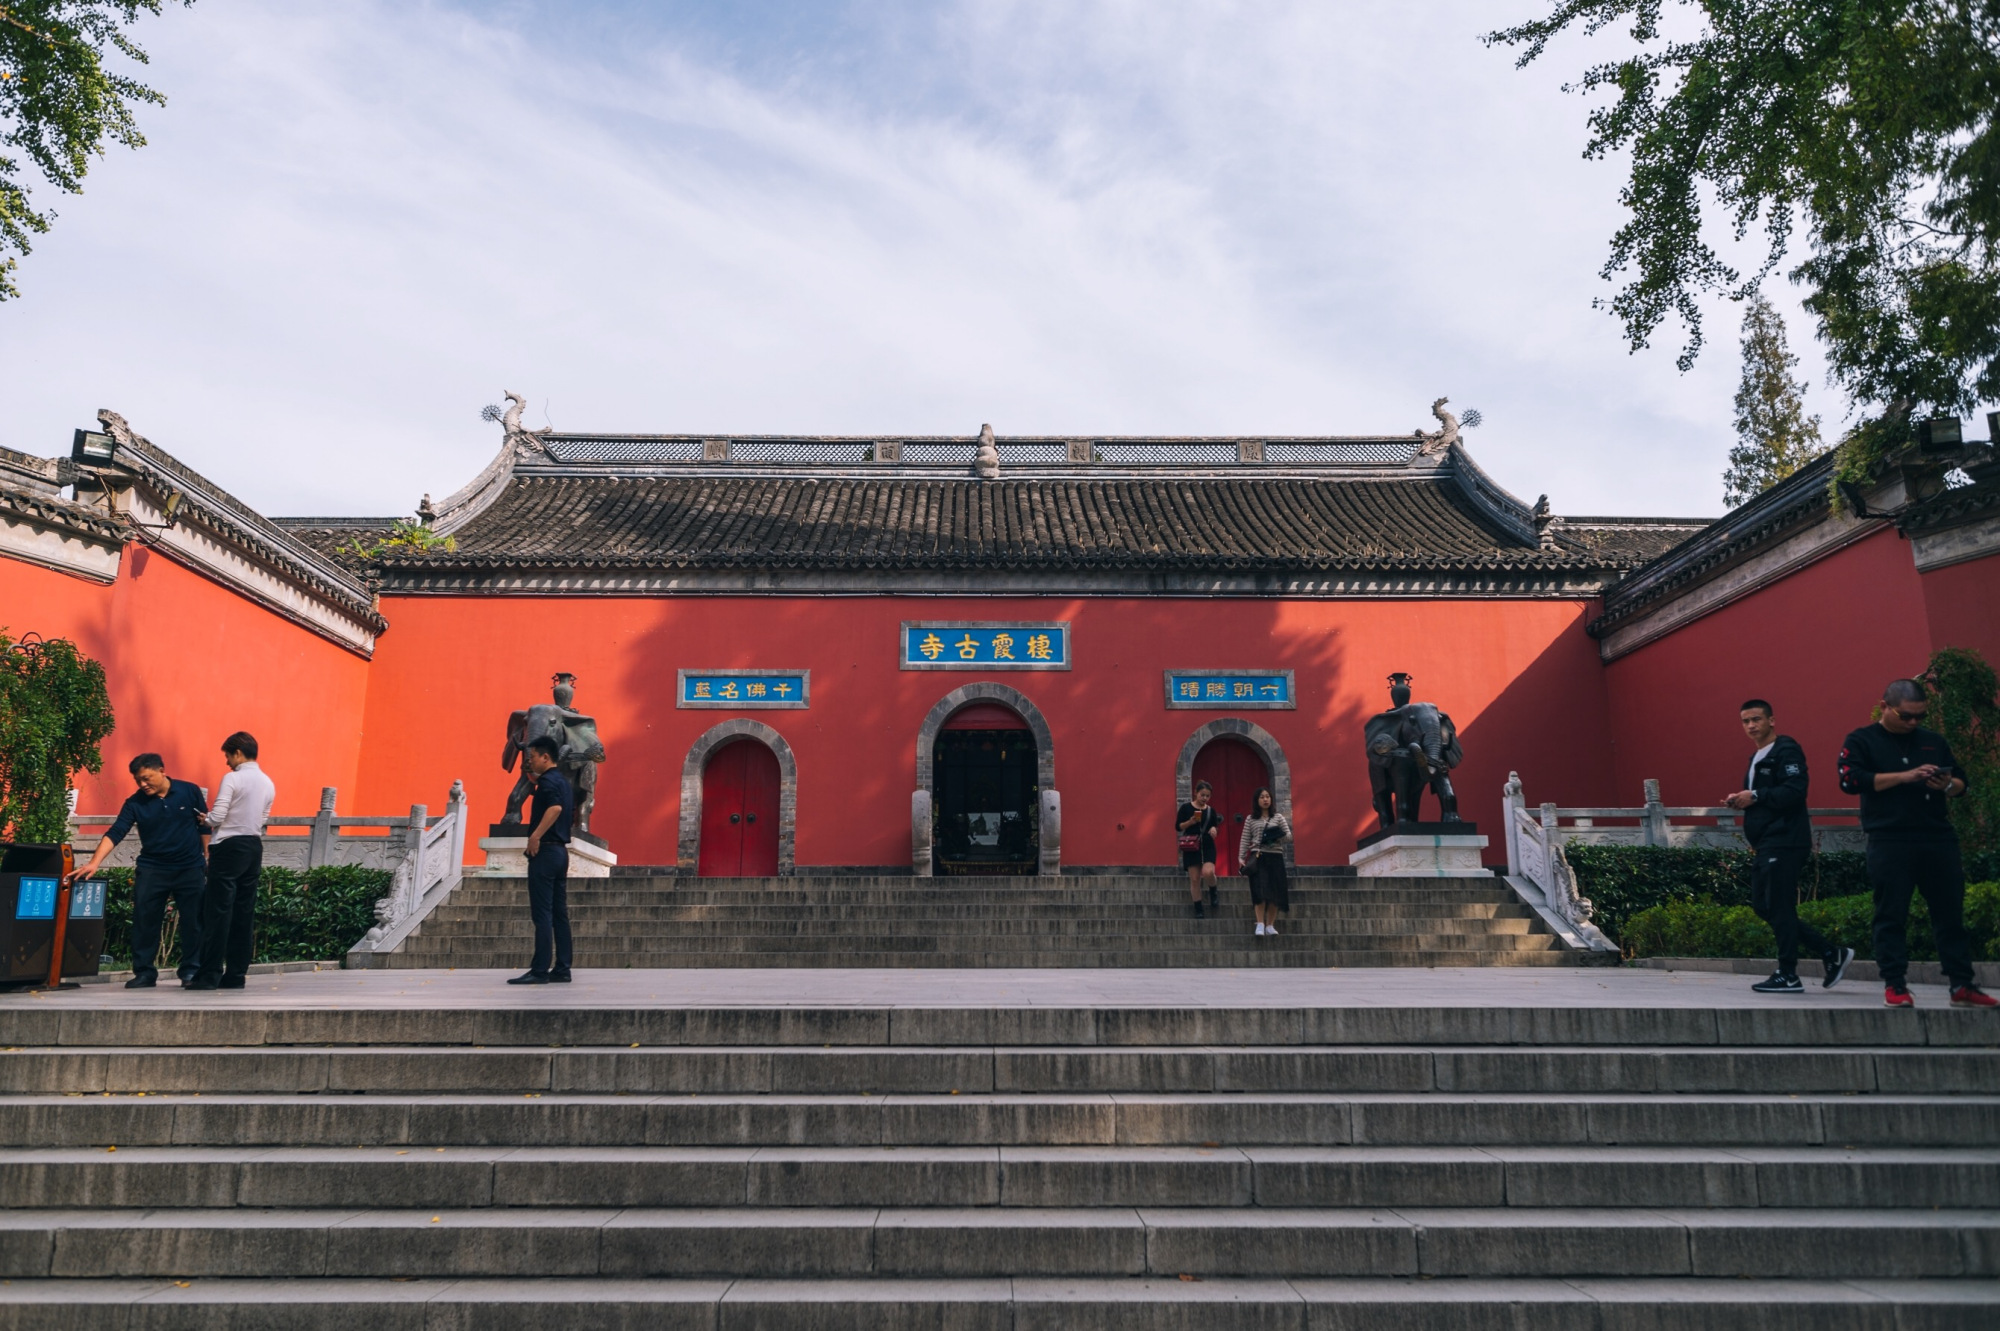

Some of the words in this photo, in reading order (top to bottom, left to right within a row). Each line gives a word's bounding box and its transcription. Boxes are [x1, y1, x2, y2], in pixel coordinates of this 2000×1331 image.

[919, 632, 1054, 660] 棲霞古寺
[693, 681, 793, 699] 千佛名藍
